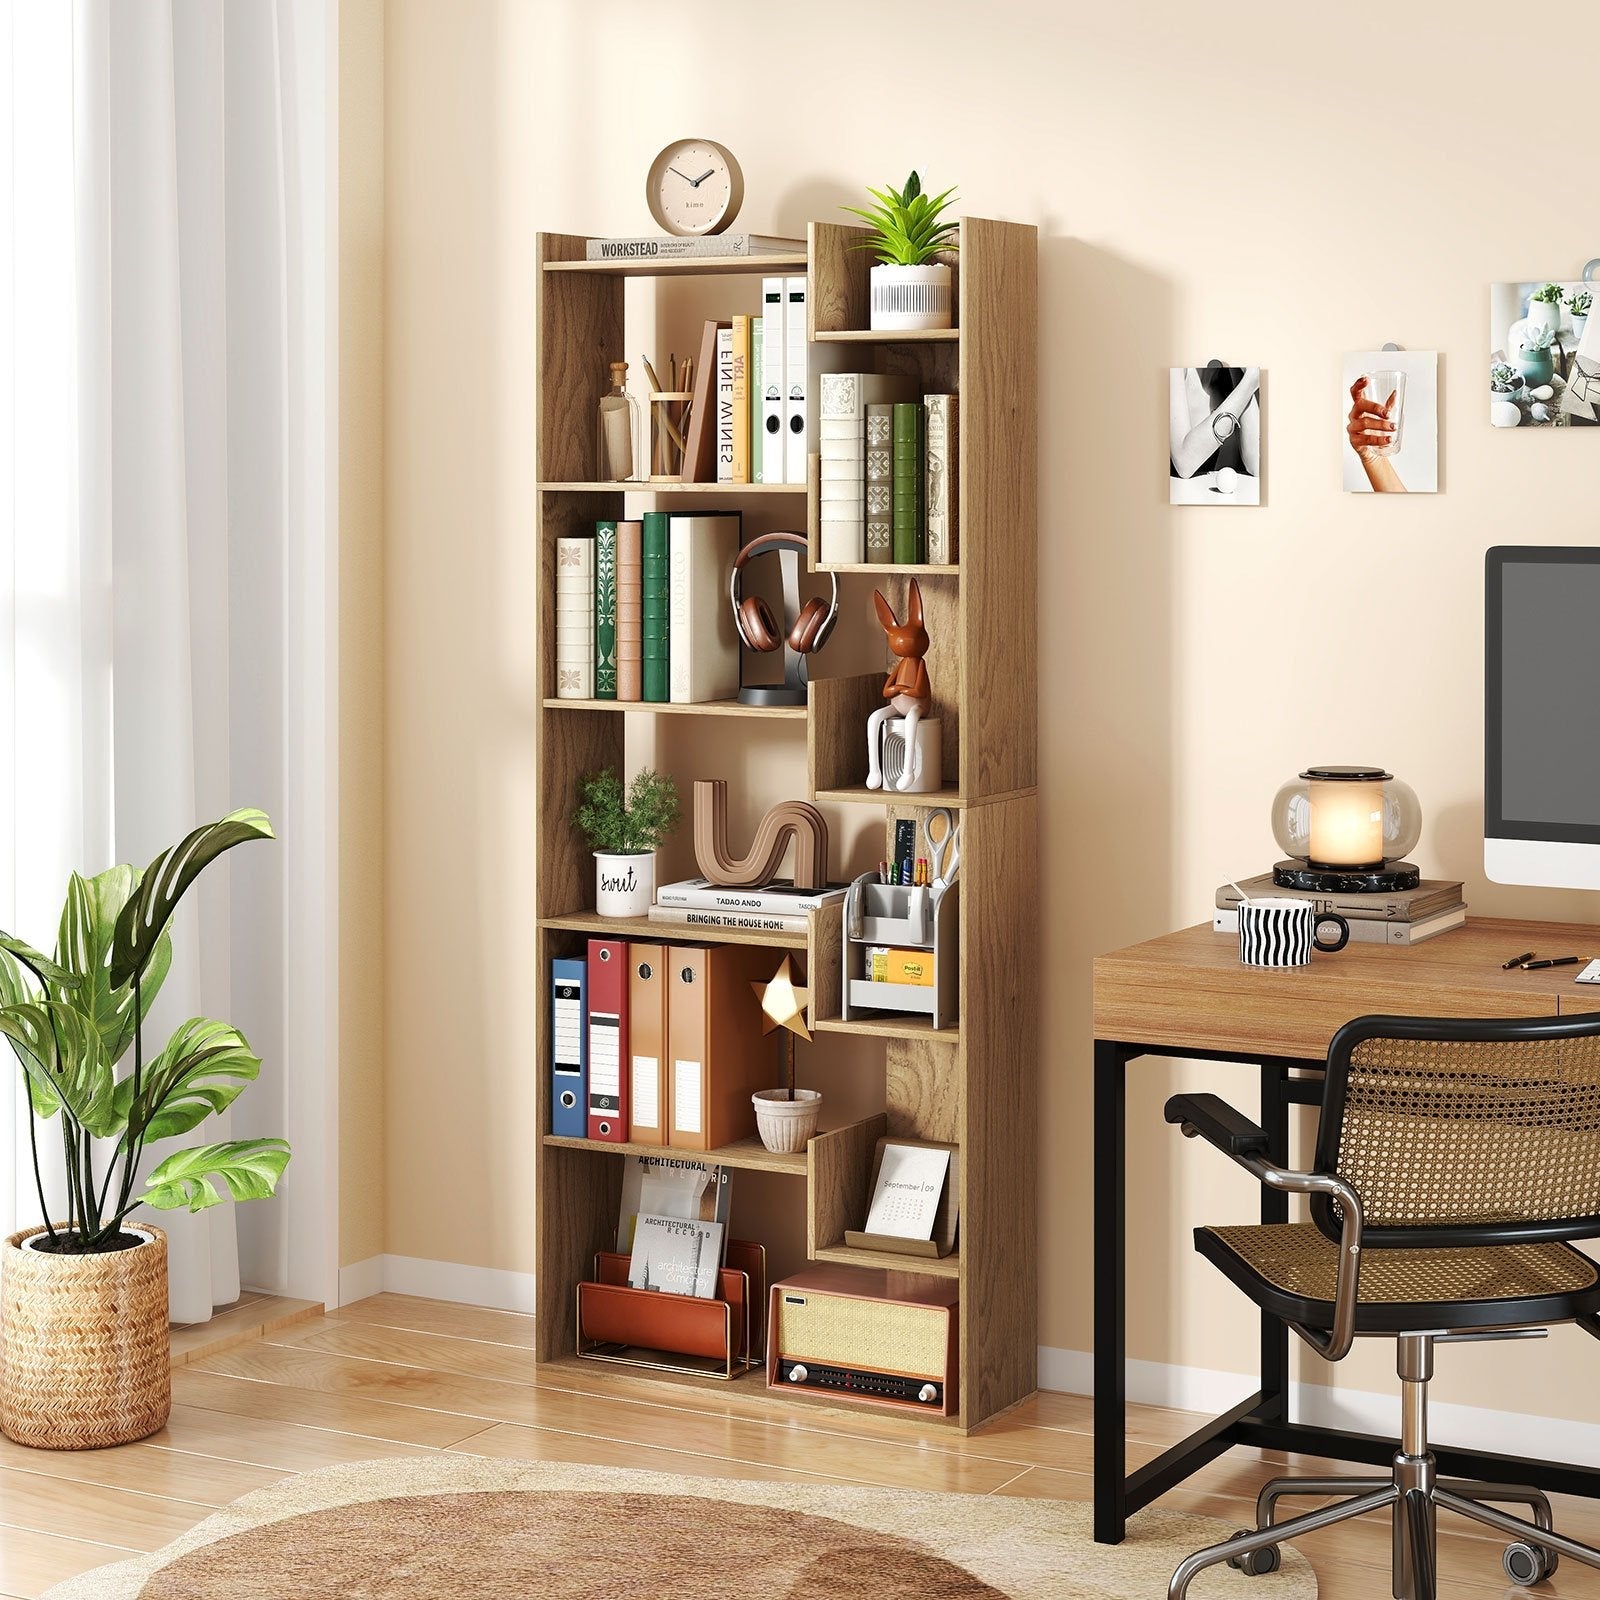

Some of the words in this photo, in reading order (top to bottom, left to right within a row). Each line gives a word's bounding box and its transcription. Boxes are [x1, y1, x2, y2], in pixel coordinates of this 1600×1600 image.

[601, 242, 658, 257] WORKSTEAD
[674, 551, 685, 625] LUXDECO
[716, 897, 740, 906] TADAO
[741, 898, 762, 907] ANDO
[687, 913, 720, 925] BRINGING
[723, 916, 737, 926] THE
[738, 917, 762, 929] HOUSE
[763, 919, 784, 930] HOME
[638, 1155, 707, 1172] ARCHITECTURAL
[884, 1180, 920, 1191] September
[645, 1218, 696, 1230] ARCHITECTURAL
[667, 1227, 711, 1239] RECORD
